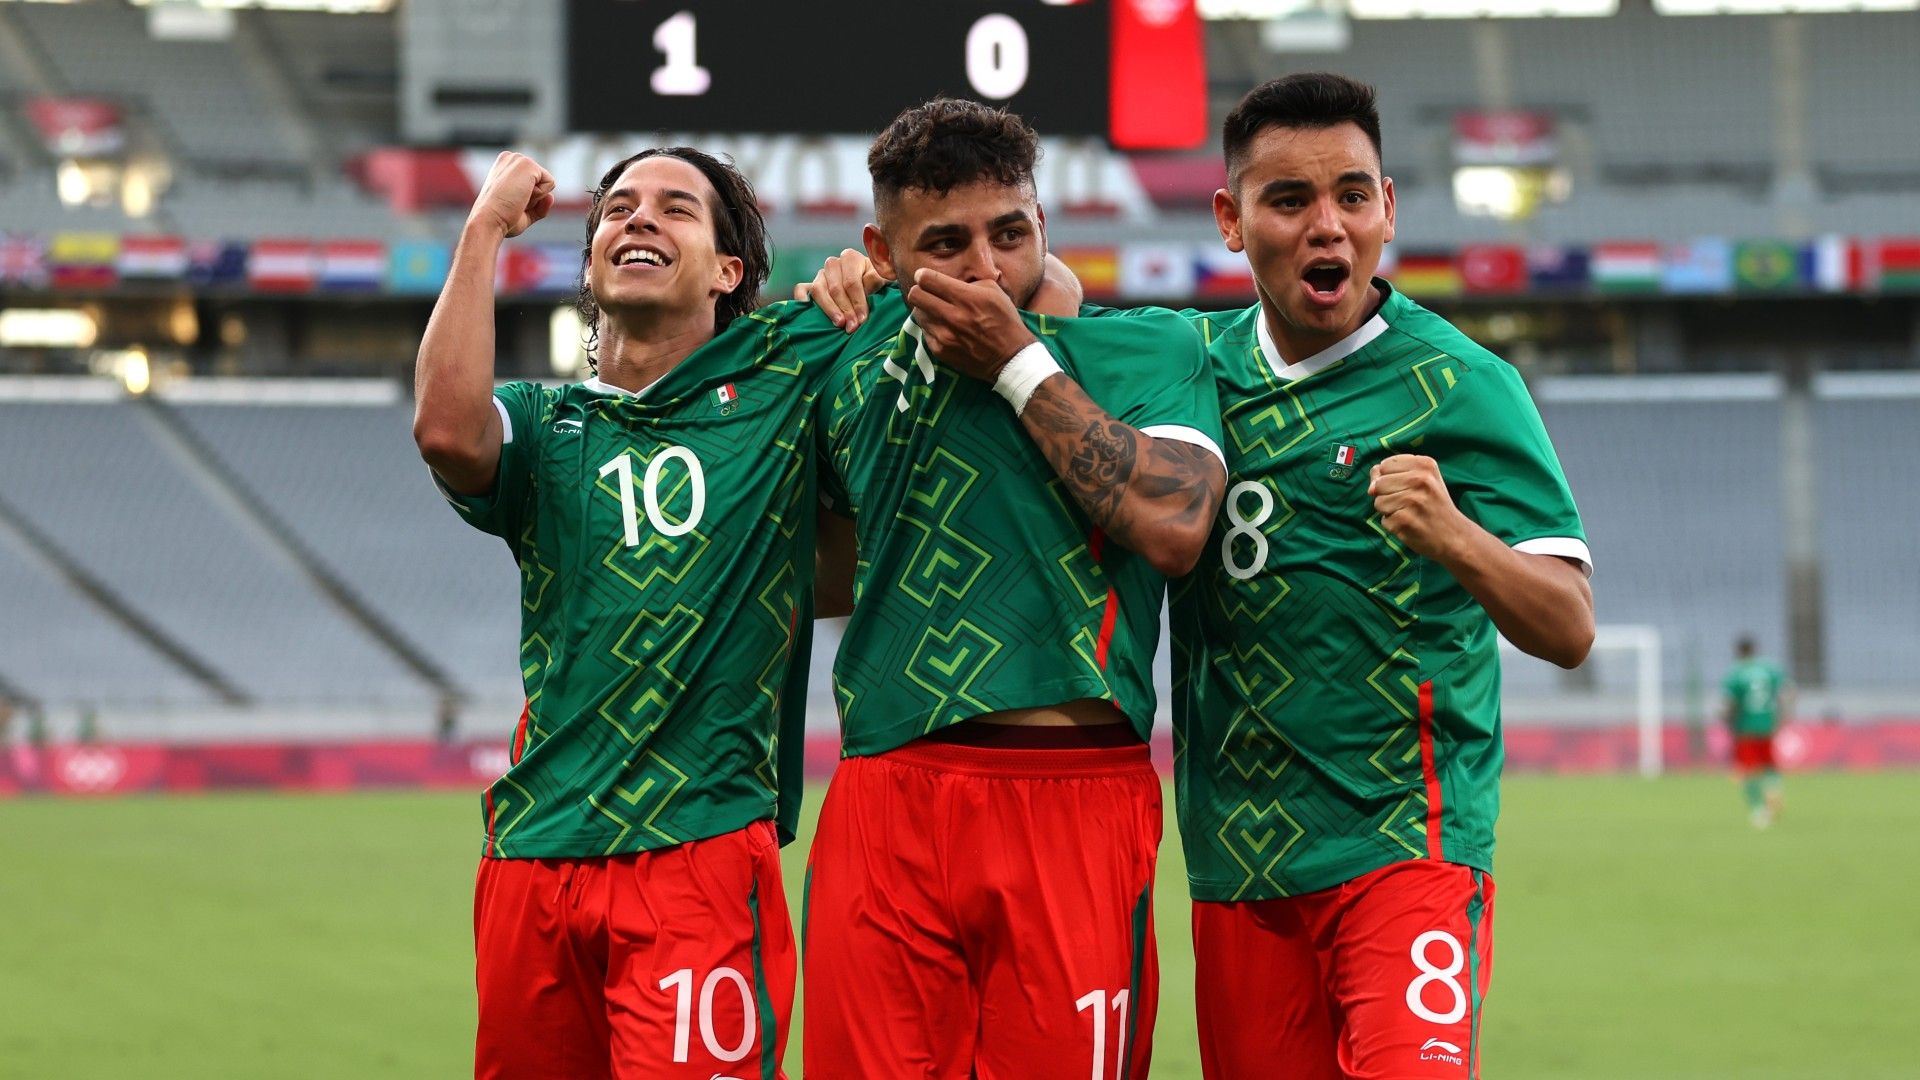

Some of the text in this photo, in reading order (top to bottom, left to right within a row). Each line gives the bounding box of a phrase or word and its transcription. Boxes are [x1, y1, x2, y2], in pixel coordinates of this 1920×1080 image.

[650, 9, 1030, 100] 1 0
[598, 445, 706, 547] 10
[1221, 480, 1274, 580] 8
[658, 966, 757, 1063] 10
[1405, 929, 1467, 1025] 8
[1075, 988, 1130, 1080] 11
[1420, 1052, 1463, 1066] LI-NING
